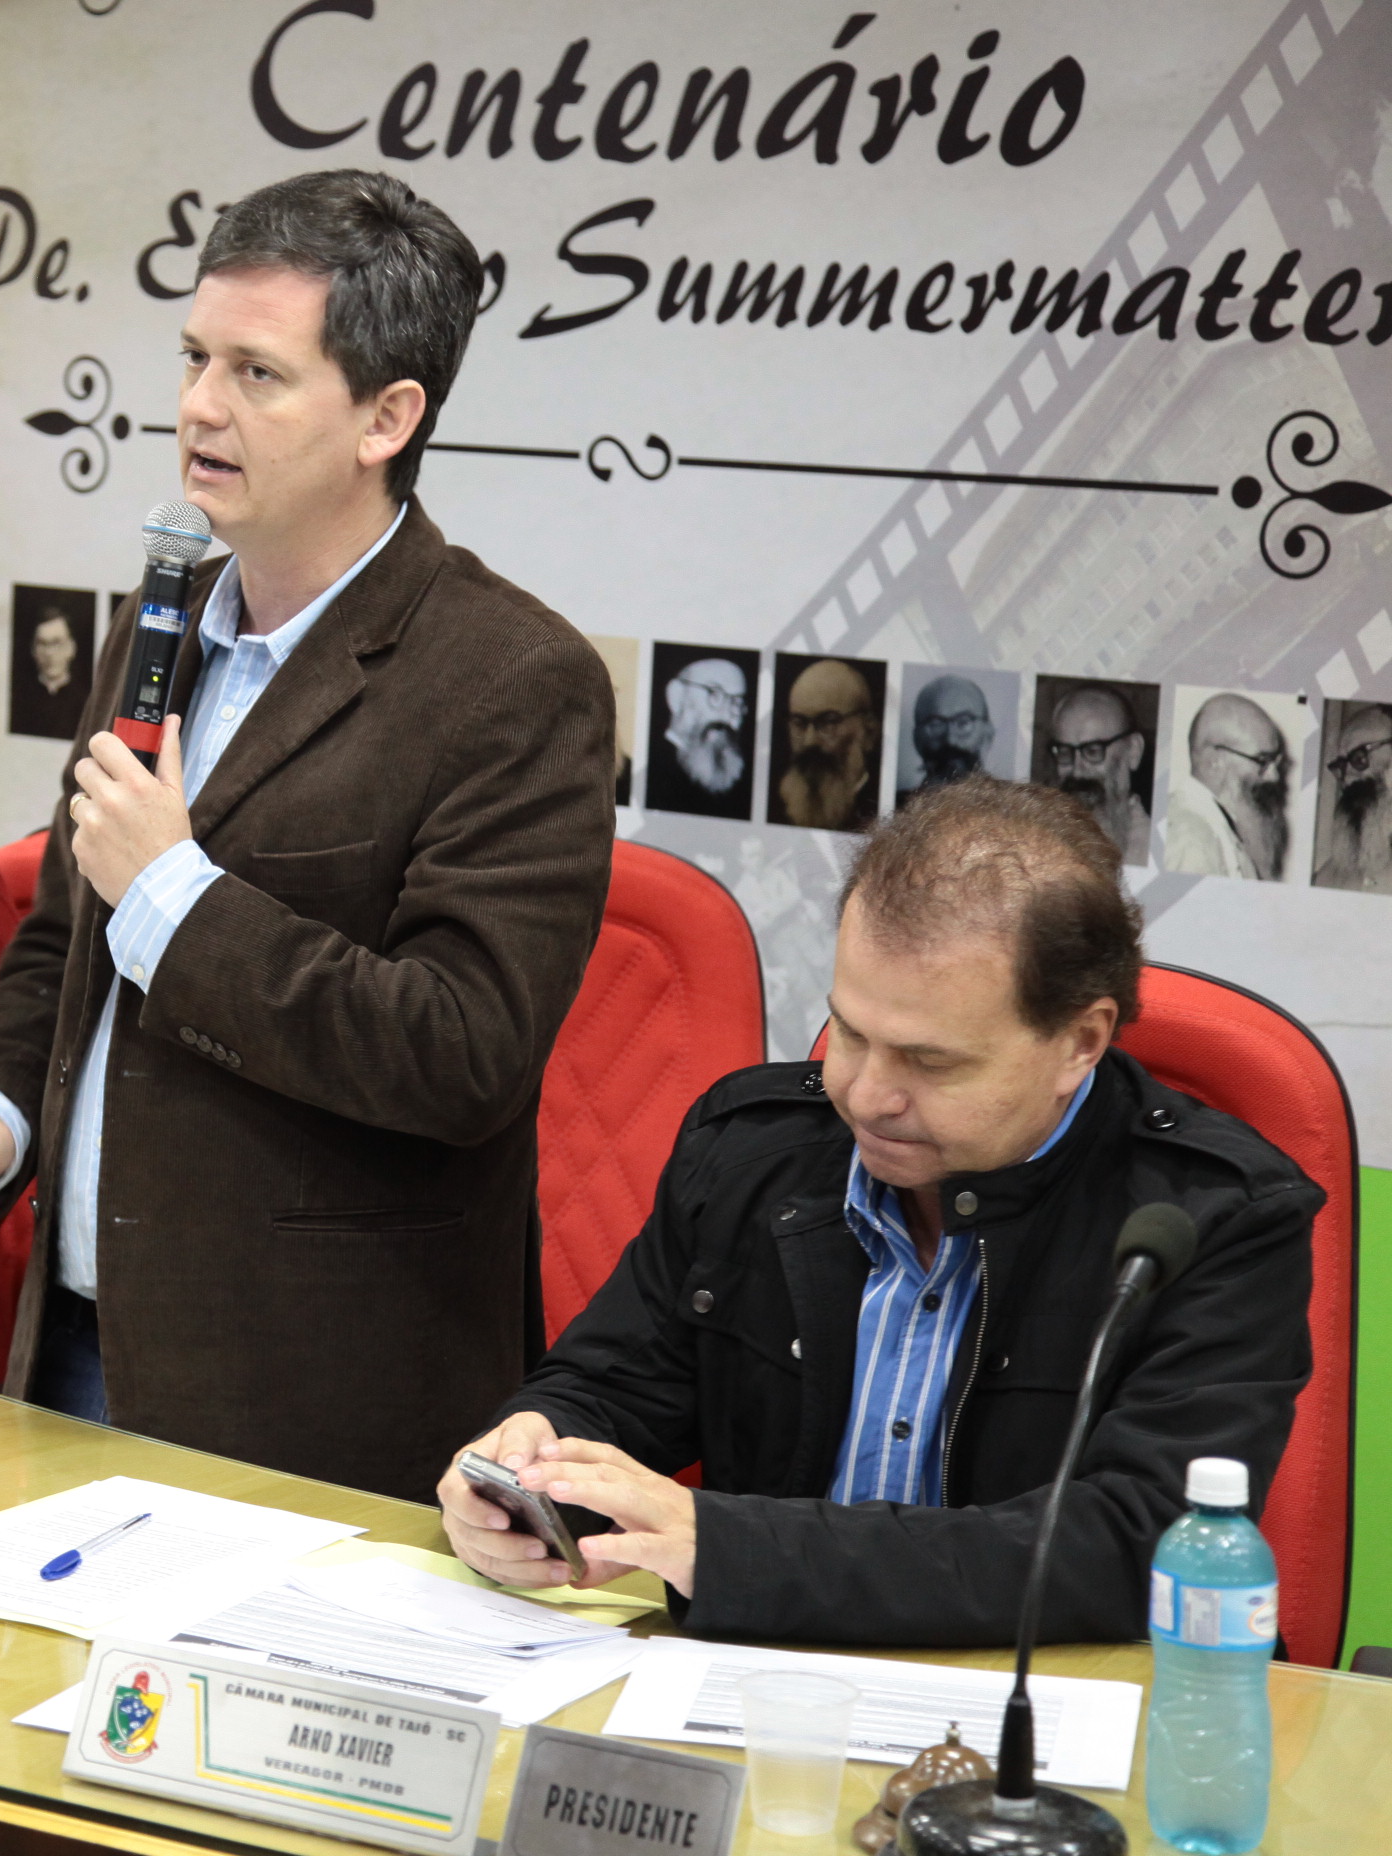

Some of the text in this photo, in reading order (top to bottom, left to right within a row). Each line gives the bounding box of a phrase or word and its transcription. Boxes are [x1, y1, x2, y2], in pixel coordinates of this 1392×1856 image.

[250, 0, 1096, 170] Centenário
[156, 567, 183, 578] SHURE
[224, 1682, 467, 1743] CÂMARA MUNICIPAL DE TAIÓ SC
[287, 1723, 395, 1768] ARNO XAVIER
[264, 1756, 405, 1797] VEREADOR PMDB
[543, 1783, 699, 1849] PRESIDENTE
